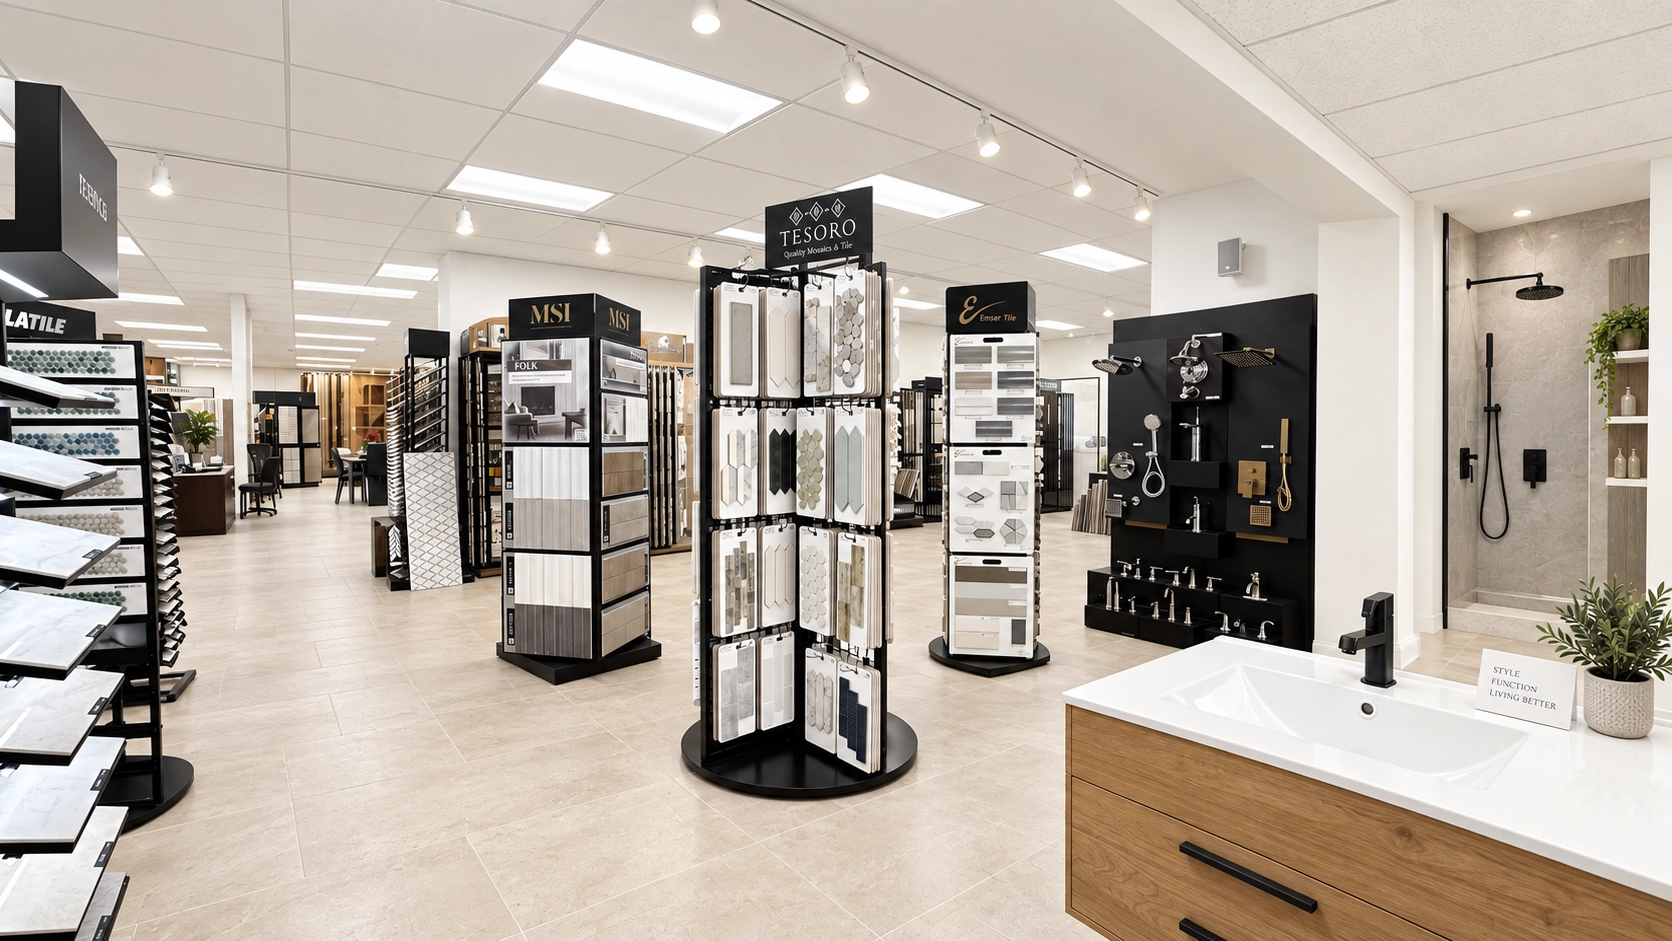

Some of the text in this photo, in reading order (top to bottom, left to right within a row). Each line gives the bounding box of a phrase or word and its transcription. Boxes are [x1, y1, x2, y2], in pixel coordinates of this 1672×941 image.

[779, 220, 856, 247] TESORO
[784, 246, 806, 260] Quality
[840, 241, 853, 250] Tile
[5, 308, 67, 335] LATILE
[530, 302, 571, 325] MSI
[609, 307, 631, 332] MSI
[980, 313, 1017, 322] Emser Tile
[514, 361, 538, 371] FOLK
[1493, 666, 1520, 678] STYLE
[1491, 677, 1538, 693] FUNCTION
[1489, 689, 1557, 710] LIVING BETTER
